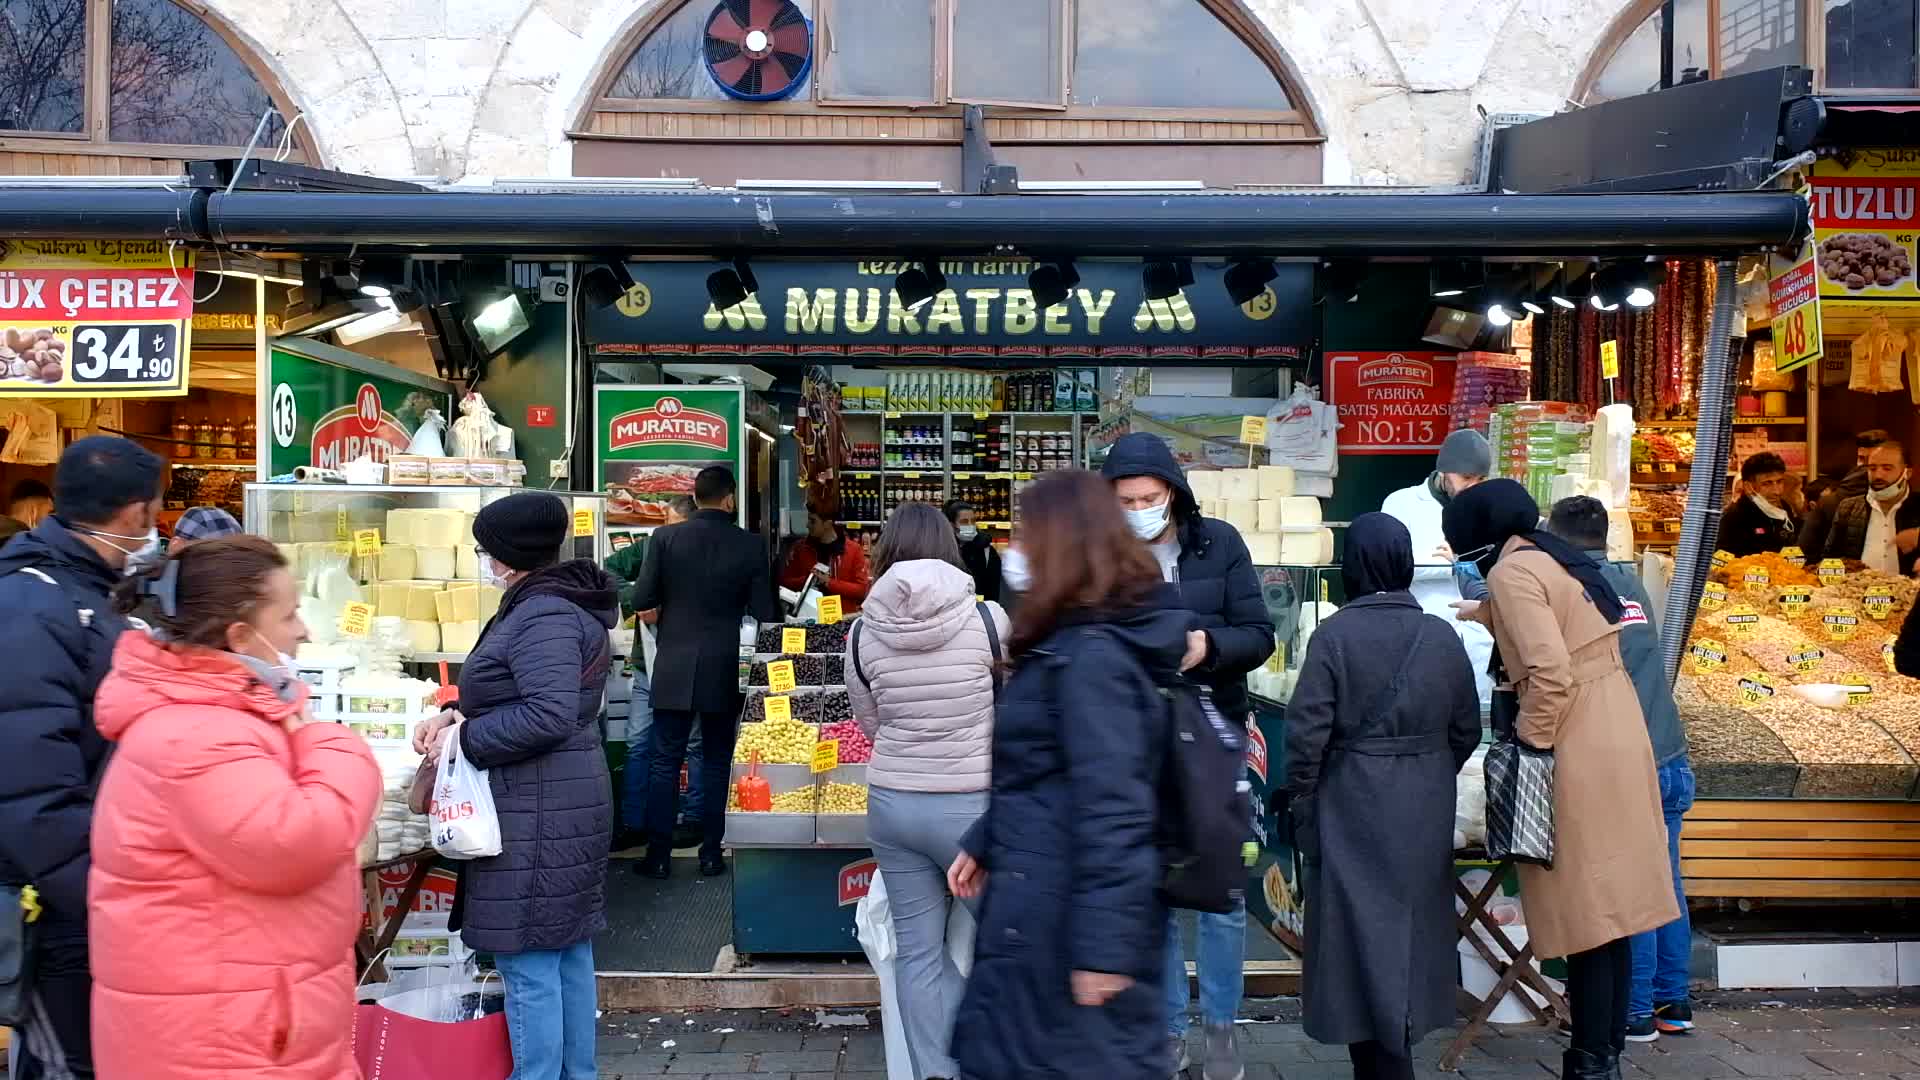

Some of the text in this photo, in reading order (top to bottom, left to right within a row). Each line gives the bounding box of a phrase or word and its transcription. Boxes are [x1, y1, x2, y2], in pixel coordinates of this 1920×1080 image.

[1813, 187, 1914, 220] TUZLU
[1896, 235, 1912, 243] KG
[60, 278, 180, 317] ÇEREZ
[785, 288, 1116, 334] MURATBEY
[1784, 310, 1806, 359] 48
[1364, 367, 1427, 379] MURATBEY
[1367, 385, 1424, 399] FABRİKA
[276, 393, 293, 437] 13
[1339, 402, 1450, 419] SATIŞ MAĞAZASI
[617, 419, 719, 439] MURATBEY
[1357, 420, 1433, 443] NO:13
